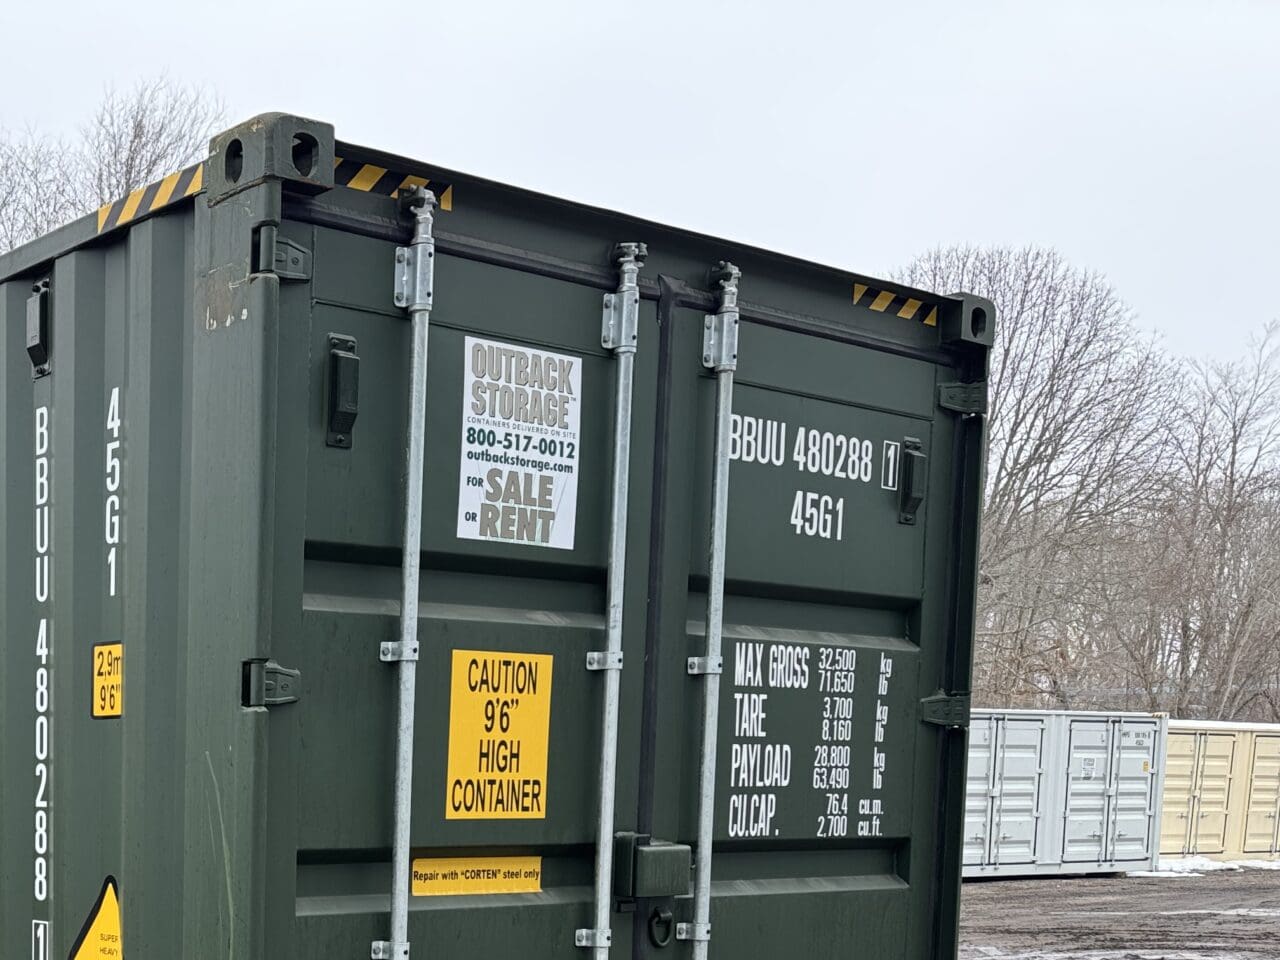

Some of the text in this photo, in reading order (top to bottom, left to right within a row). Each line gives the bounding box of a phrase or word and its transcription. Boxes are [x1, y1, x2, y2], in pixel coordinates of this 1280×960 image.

[471, 342, 574, 395] OUTBACK
[471, 380, 569, 430] STORAGE
[466, 427, 576, 459] 800-517-0012
[467, 416, 510, 429] CONTAINERS
[512, 423, 549, 435] DELIVERED
[562, 432, 577, 440] SITE
[467, 449, 574, 474] outbackstorage.com
[728, 413, 787, 467] BBUU
[793, 426, 873, 483] 480288
[35, 405, 49, 603] BBUU
[105, 386, 120, 597] 45G1
[466, 467, 554, 509] FOR SALE
[464, 503, 556, 544] OR RENT
[790, 490, 844, 541] 45G1
[468, 658, 539, 695] CAUTION
[734, 642, 893, 689] MAX GROSS 32,500 kg
[819, 670, 889, 695] 71,650 lb
[734, 693, 888, 737] TARE 3,700 kg
[821, 720, 884, 742] 8,160 lb
[35, 618, 49, 901] 480288
[478, 739, 521, 773] HIGH
[730, 743, 886, 787] PAYLOAD 28,800 kg
[452, 779, 541, 812] CONTAINER
[812, 767, 883, 790] 63,490 lb
[826, 793, 849, 815] 76.4
[858, 799, 884, 815] cu.m.
[816, 816, 848, 837] 2,700
[413, 870, 439, 883] Repair
[441, 869, 459, 880] with
[502, 868, 522, 879] steel
[523, 868, 540, 880] only
